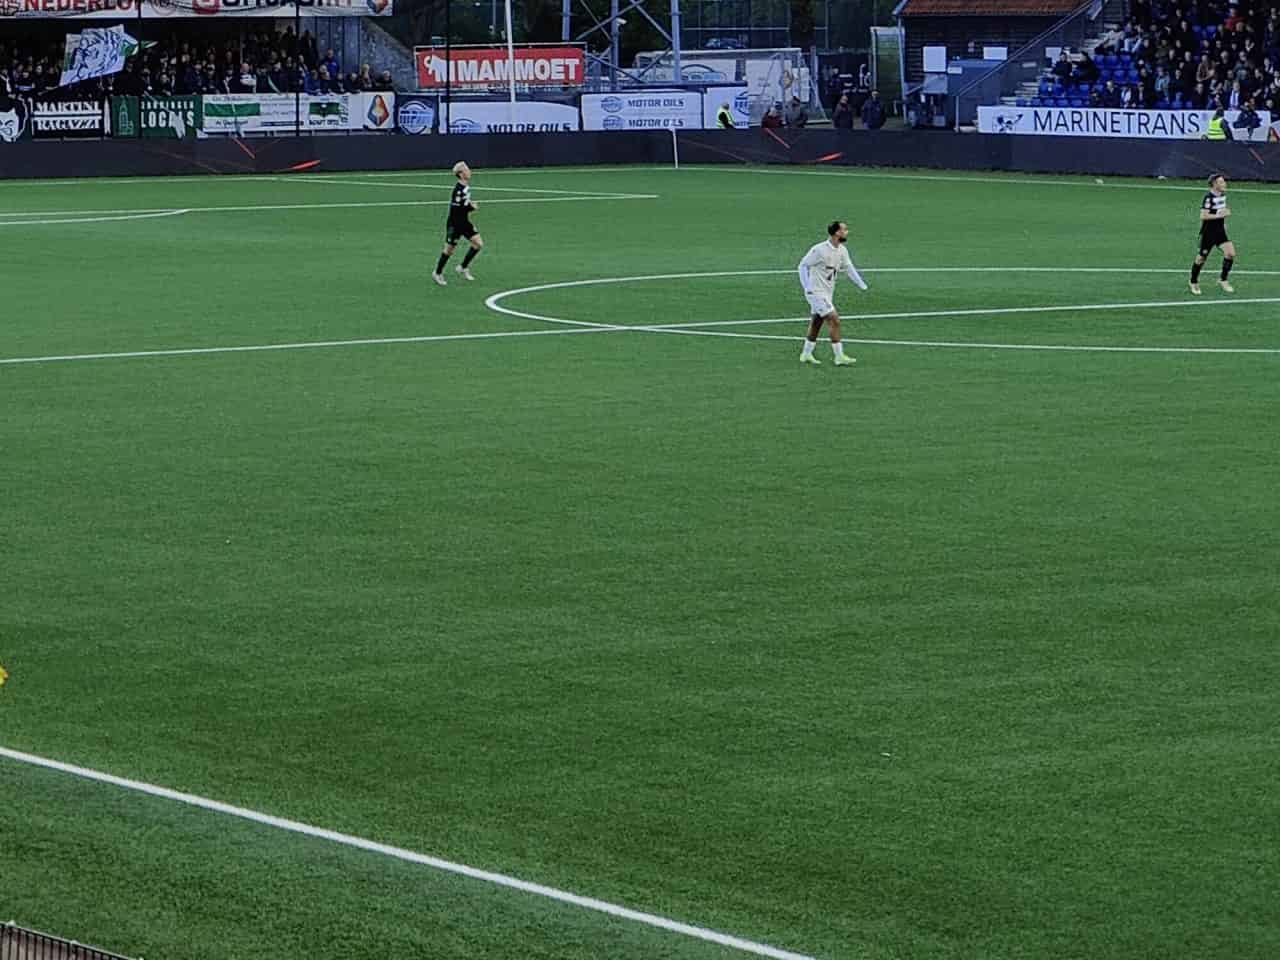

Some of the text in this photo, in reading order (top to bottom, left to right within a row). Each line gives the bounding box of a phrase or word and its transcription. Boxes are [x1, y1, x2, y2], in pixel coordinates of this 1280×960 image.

[457, 58, 581, 82] MAMMOET
[628, 99, 661, 107] MOTOR
[663, 99, 684, 107] OILS
[628, 119, 661, 128] MOTOR
[1031, 109, 1201, 136] MARINETRANS
